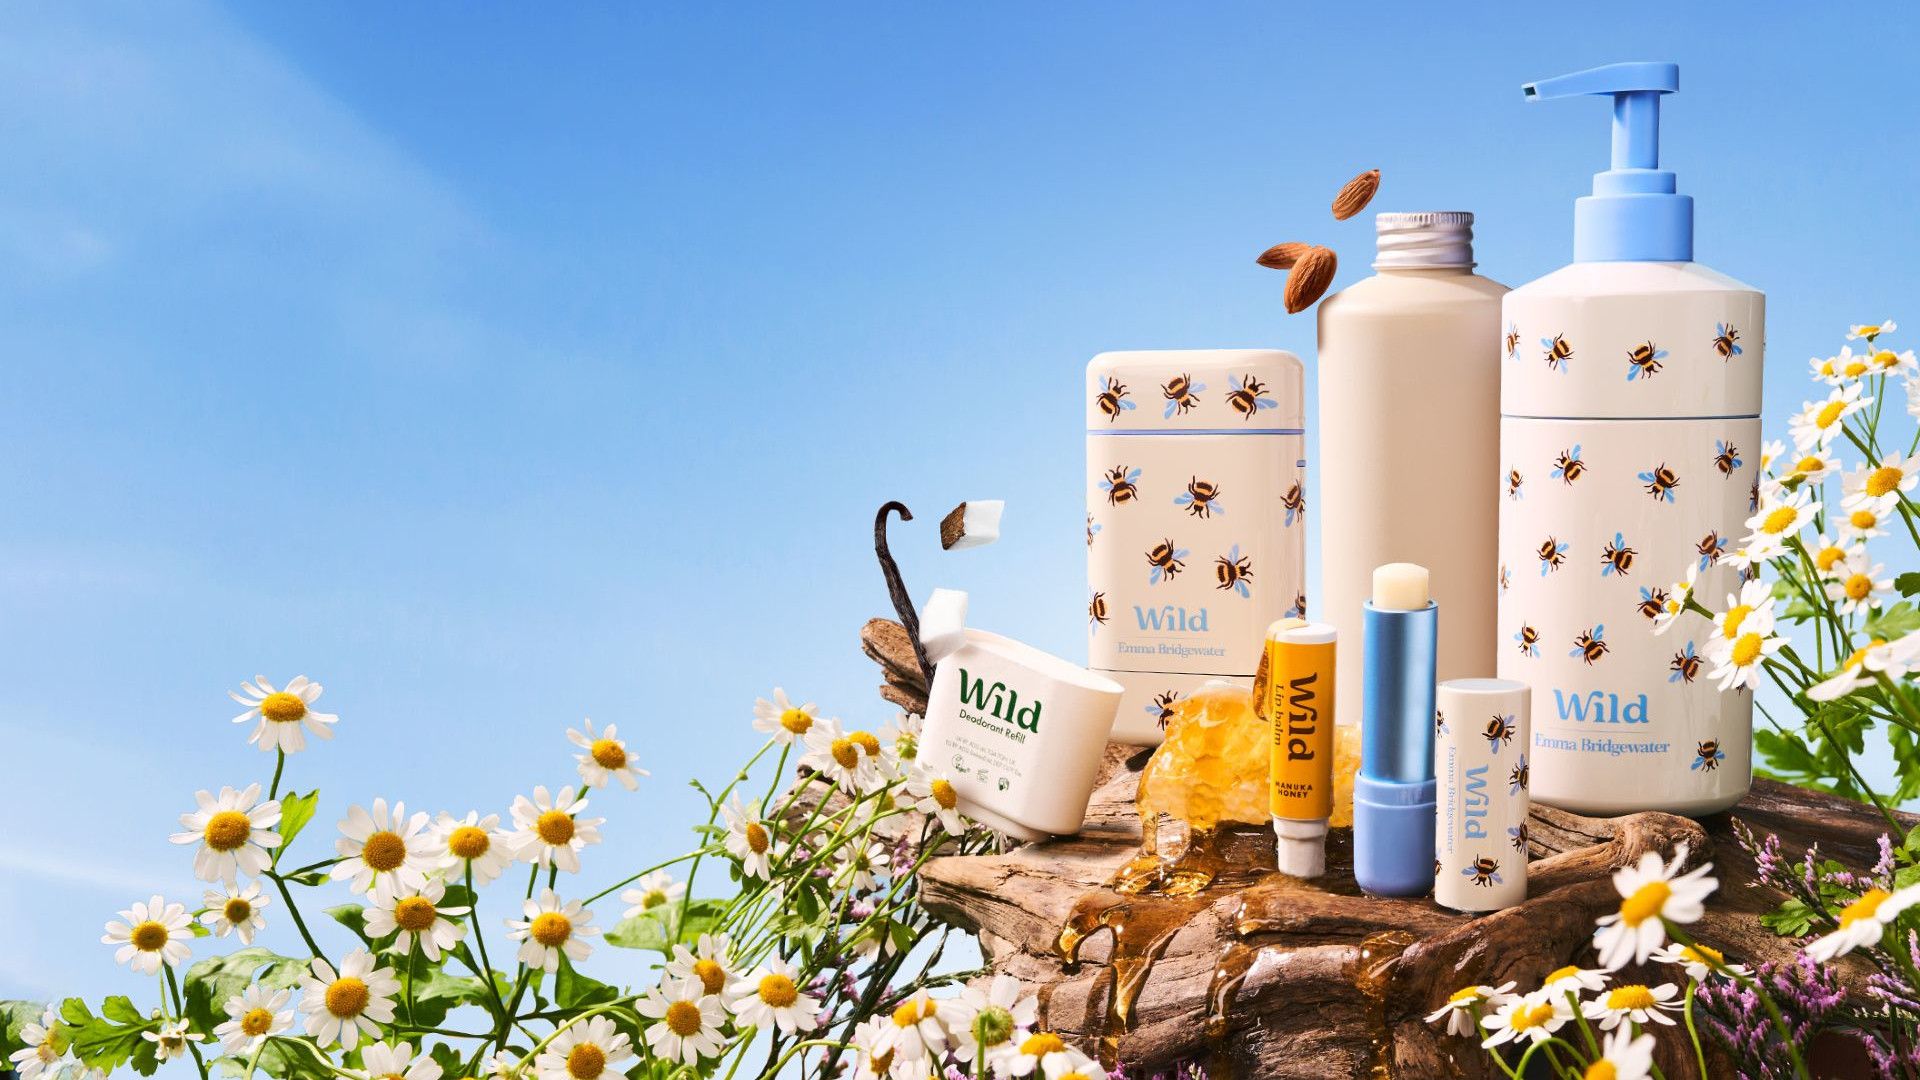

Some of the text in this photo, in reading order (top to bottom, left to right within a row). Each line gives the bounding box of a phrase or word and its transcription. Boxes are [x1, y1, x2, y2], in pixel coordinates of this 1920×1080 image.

[1133, 605, 1208, 632] Wild
[1117, 642, 1225, 658] Emma Bridgewater
[959, 668, 1042, 733] Wild
[1275, 684, 1284, 746] Lip balm
[1288, 672, 1317, 761] Wild
[1553, 689, 1649, 724] Wild
[959, 708, 1026, 745] Deodorant Refill
[1535, 732, 1670, 756] Emma Bridgewater
[1275, 781, 1313, 791] MANUKA
[1278, 789, 1308, 798] HONEY
[1447, 746, 1457, 854] Emma Bridgewater
[1465, 764, 1489, 839] Wild
